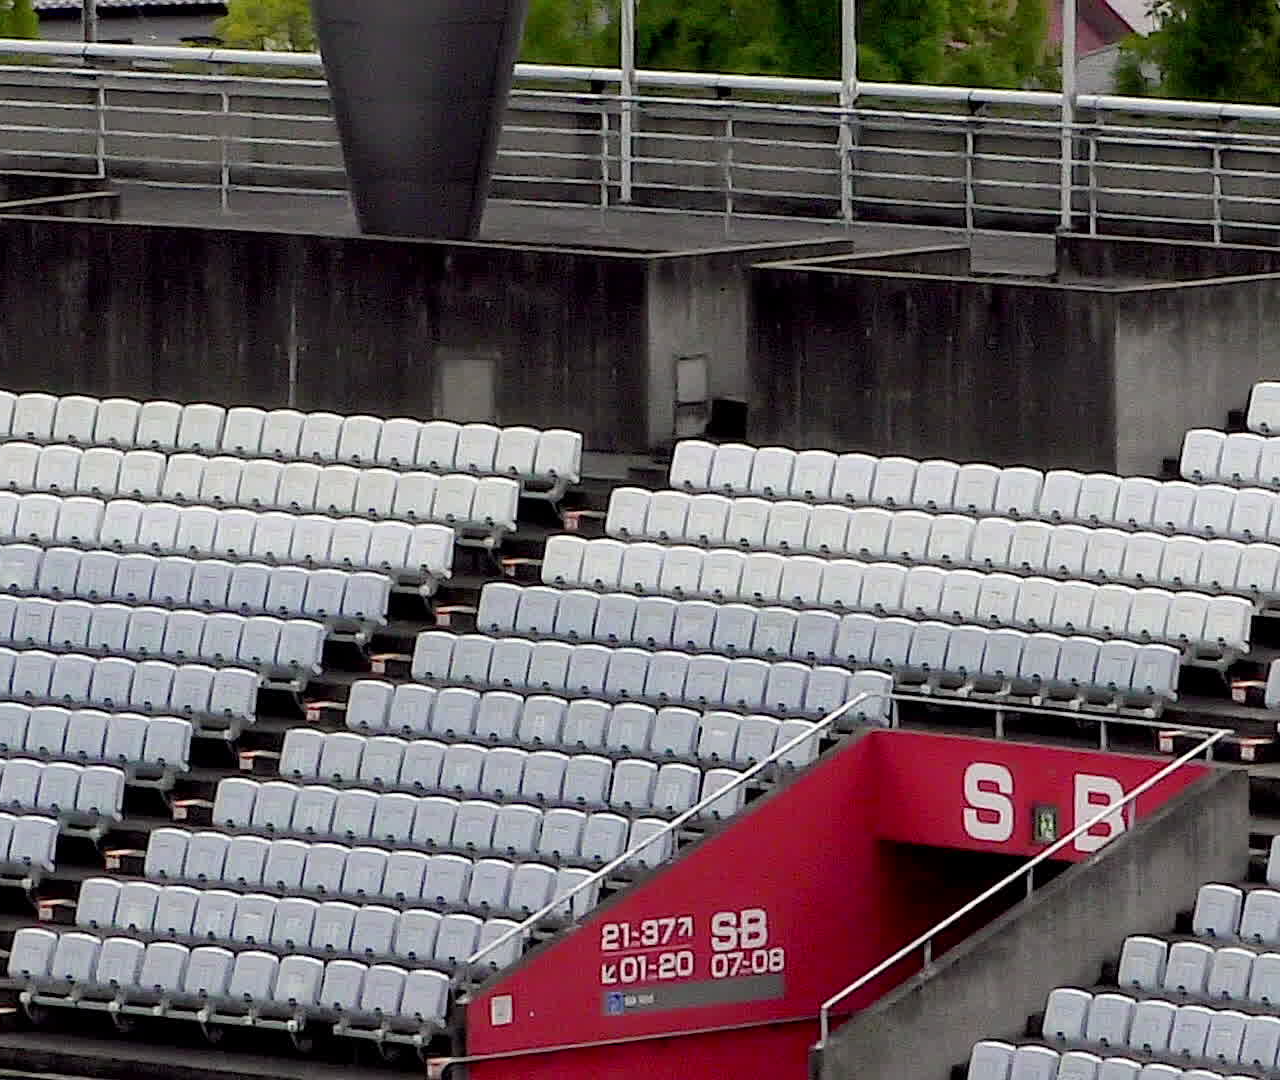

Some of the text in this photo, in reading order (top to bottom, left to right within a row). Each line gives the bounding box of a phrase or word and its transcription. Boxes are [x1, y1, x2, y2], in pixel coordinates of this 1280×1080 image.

[964, 762, 1125, 851] S B
[601, 917, 676, 951] 21-37
[620, 950, 694, 983] 01-20
[711, 947, 785, 978] 07-08
